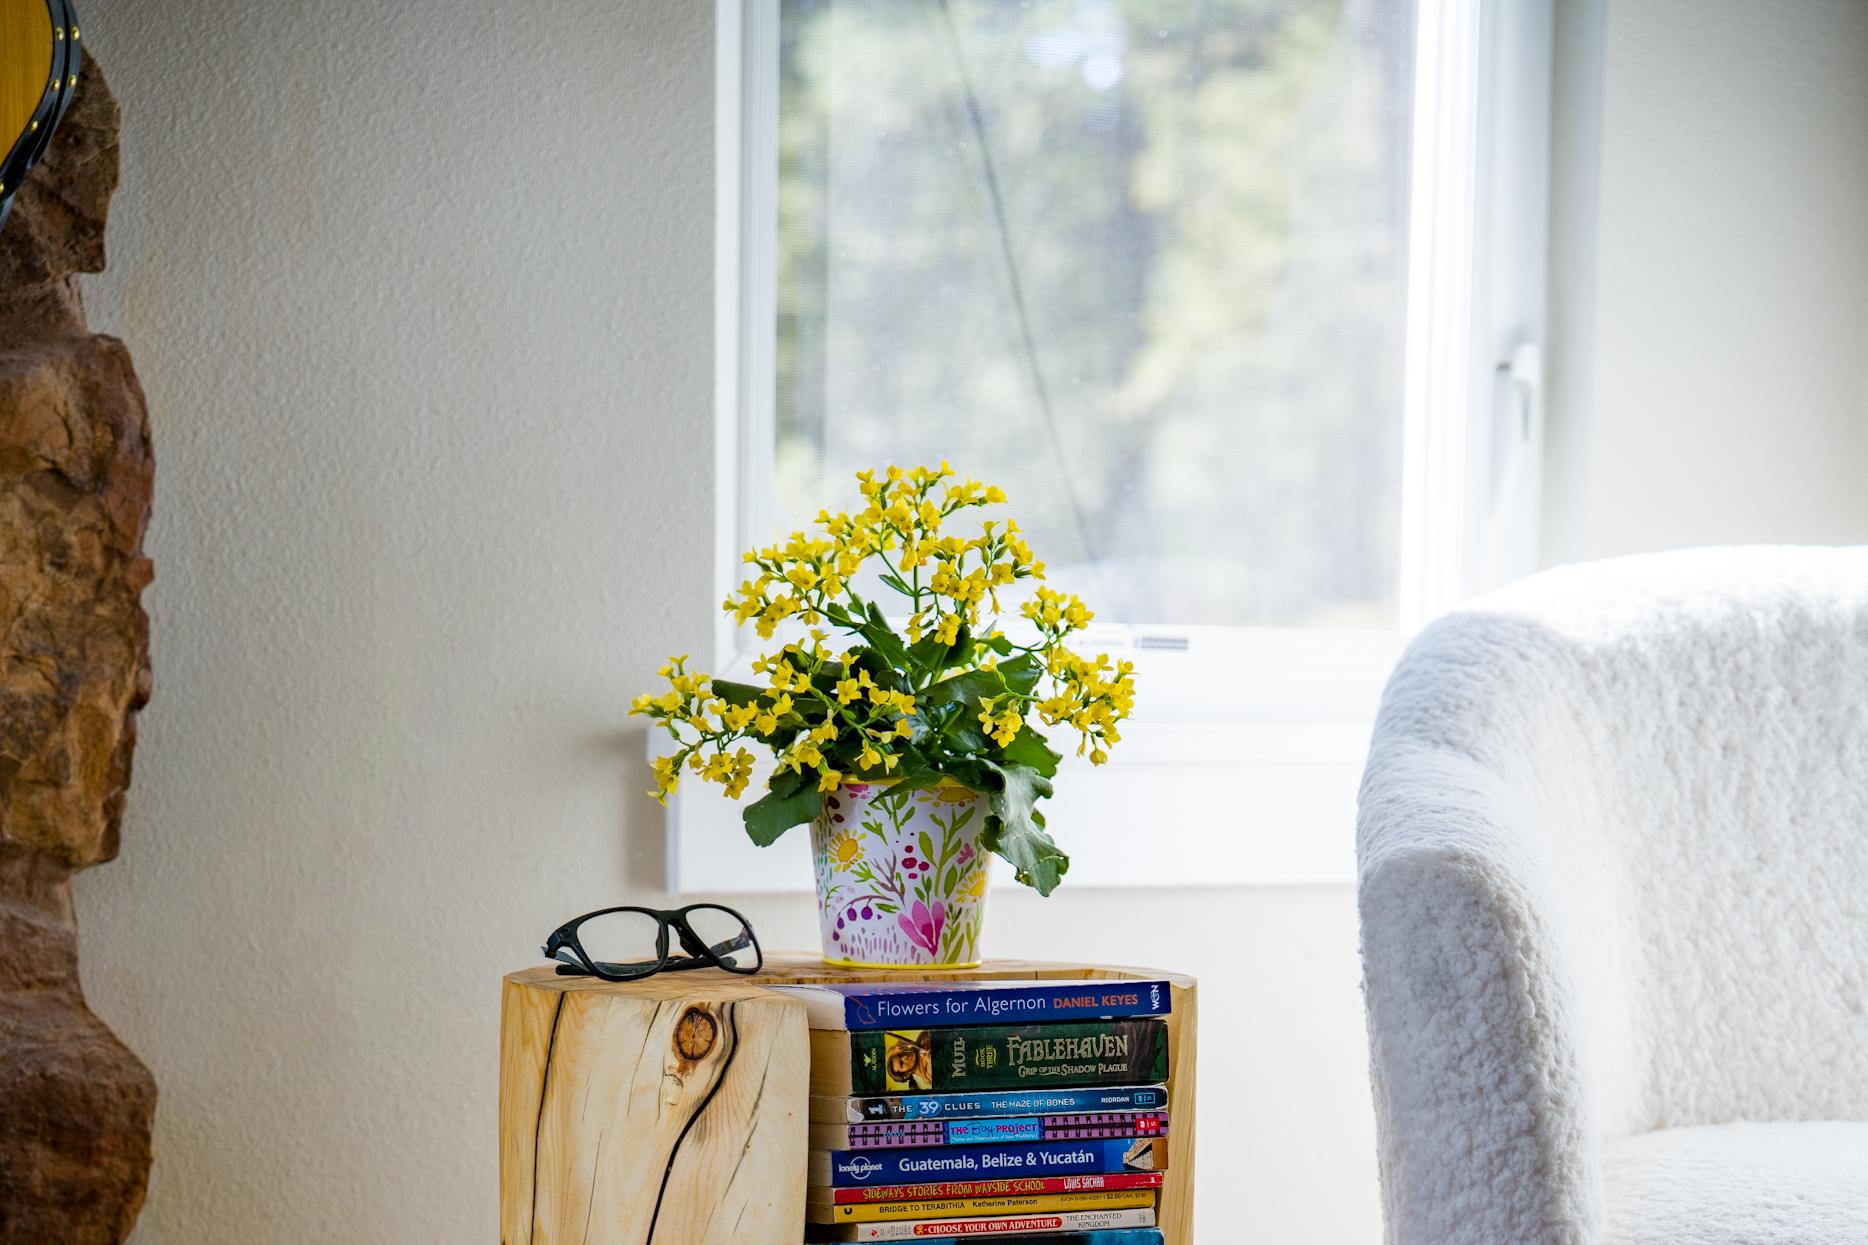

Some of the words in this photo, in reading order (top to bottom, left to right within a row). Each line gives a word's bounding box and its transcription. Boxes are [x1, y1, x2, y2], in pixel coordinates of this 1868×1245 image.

[878, 1000, 940, 1017] Flowers
[946, 997, 968, 1013] for
[974, 996, 1046, 1016] Algernon
[1053, 996, 1099, 1009] DANIEL
[1101, 994, 1138, 1007] KEYES
[1006, 1033, 1129, 1067] FABLEHAVEN
[1018, 1064, 1039, 1078] GRIP
[1039, 1066, 1048, 1074] OF
[1060, 1063, 1097, 1076] SHADOW
[1098, 1063, 1129, 1075] PLAGUE
[991, 1101, 1007, 1109] THE
[1009, 1100, 1031, 1108] MAZE
[1033, 1099, 1043, 1107] OF
[1046, 1098, 1076, 1106] BONES
[1101, 1096, 1130, 1104] RIORDAN
[892, 1104, 913, 1114] THE
[918, 1101, 939, 1115] 39
[944, 1102, 982, 1111] CLUES
[898, 1154, 979, 1172] Guatemala,
[982, 1152, 1023, 1168] Belize
[1026, 1151, 1037, 1165] &
[1039, 1149, 1095, 1165] Yucatán
[838, 1163, 860, 1174] lonely
[860, 1162, 883, 1174] planet
[863, 1188, 905, 1200] SIDEWAYS
[907, 1186, 944, 1198] STORIES
[946, 1184, 973, 1195] FROM
[975, 1181, 1010, 1194] WAYSIDE
[1014, 1180, 1046, 1192] SCHOOL
[1063, 1178, 1081, 1191] LOUIS
[1082, 1176, 1105, 1189] SACHAR
[879, 1206, 908, 1214] BRIDGE
[910, 1204, 920, 1212] TO
[922, 1202, 966, 1211] TERABITHIA
[972, 1199, 1006, 1208] Katherine
[1007, 1198, 1038, 1207] Paterson
[1080, 1212, 1122, 1222] ENCHANTED
[928, 1223, 963, 1234] CHOOSE
[963, 1222, 989, 1233] YOUR
[991, 1221, 1008, 1232] OWN
[1008, 1218, 1058, 1231] ADVENTURE
[1078, 1220, 1110, 1229] KINGDOM
